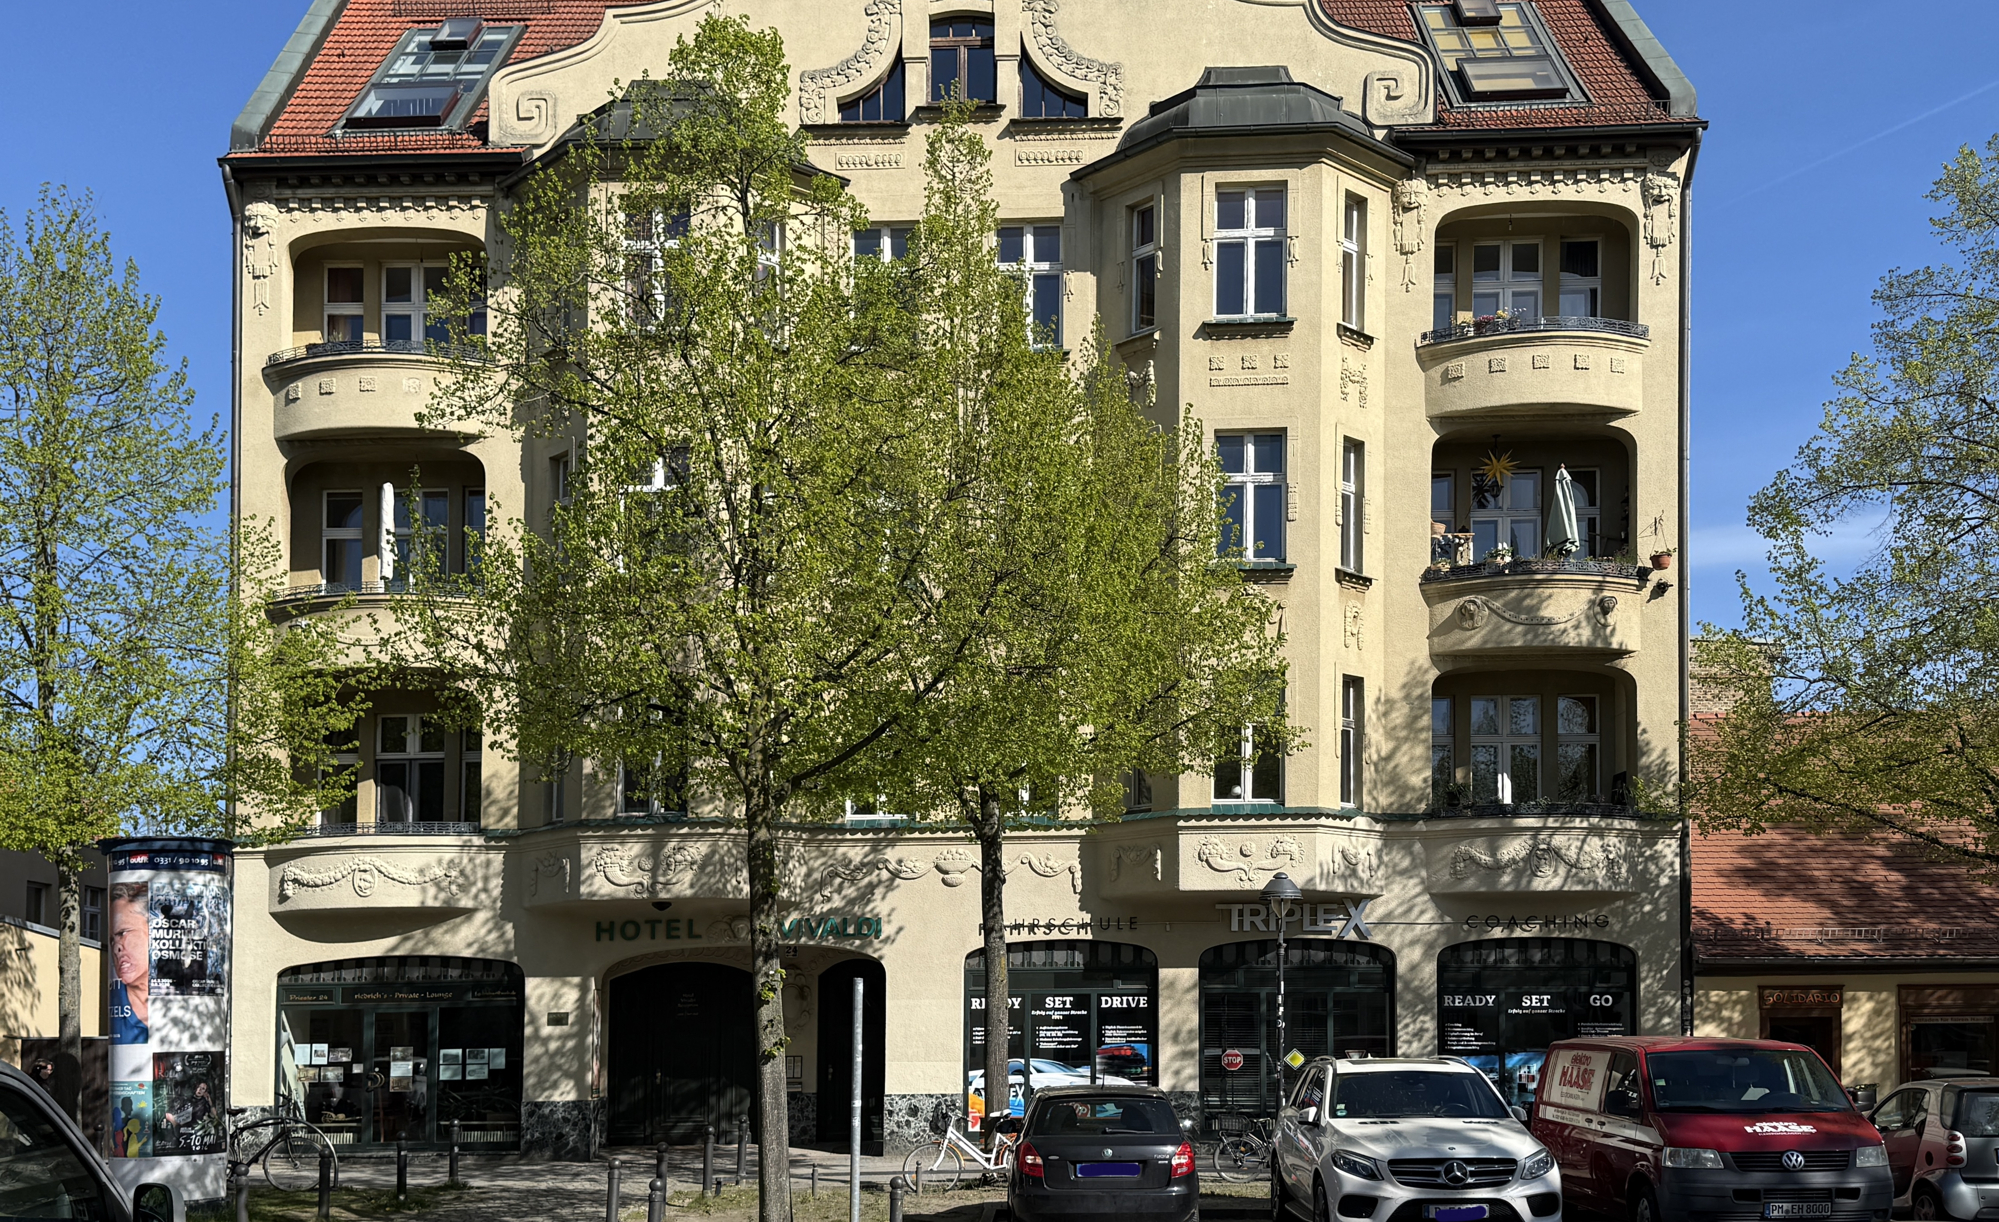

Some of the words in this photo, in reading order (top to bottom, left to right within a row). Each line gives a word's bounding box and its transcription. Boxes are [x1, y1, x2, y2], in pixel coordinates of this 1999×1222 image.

[153, 919, 195, 928] OSCAR
[1215, 898, 1373, 937] TRIPLEX
[1466, 914, 1609, 929] COACHING
[595, 918, 702, 942] HOTEL
[778, 917, 882, 940] VIVALDI
[426, 991, 453, 1000] Lounge
[1444, 995, 1496, 1007] READY
[1522, 995, 1551, 1007] SET
[1590, 995, 1613, 1007] GO
[1764, 992, 1840, 1005] SOLIDARIO
[1045, 997, 1073, 1008] SET
[1101, 996, 1148, 1008] DRIVE
[1223, 1056, 1241, 1064] STOP
[1570, 1052, 1592, 1066] elektro
[1559, 1065, 1595, 1091] HAASE
[203, 1135, 216, 1145] MAI
[1771, 1204, 1784, 1214] PM
[1791, 1204, 1804, 1214] EH
[1806, 1204, 1830, 1214] 8000
